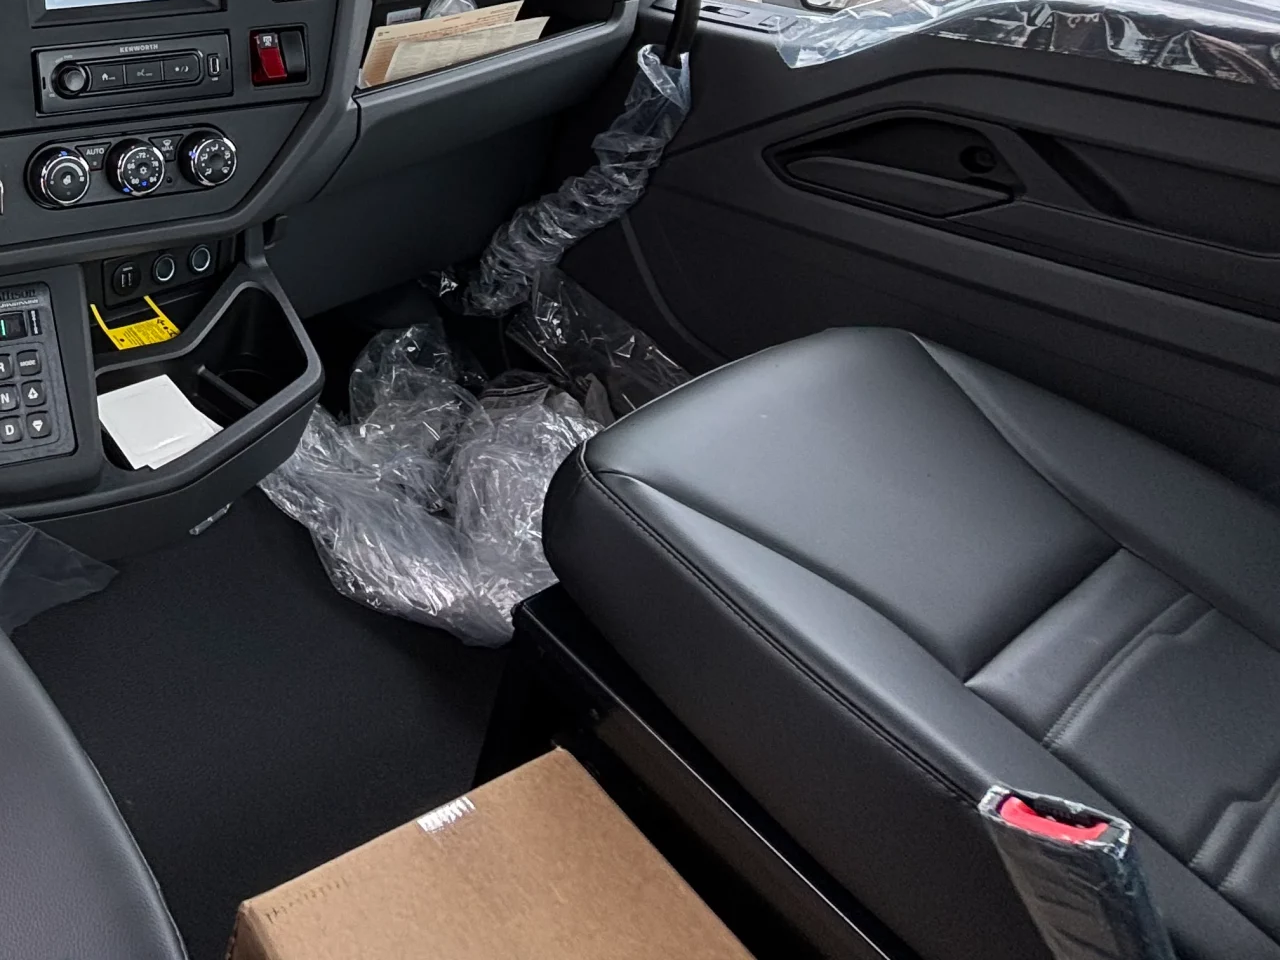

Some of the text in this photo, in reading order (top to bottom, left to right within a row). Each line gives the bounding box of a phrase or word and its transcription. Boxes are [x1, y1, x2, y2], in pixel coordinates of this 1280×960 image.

[119, 44, 159, 53] KENWORTH
[86, 147, 105, 156] AUTO
[20, 359, 36, 368] MODE
[0, 392, 10, 404] N
[5, 424, 15, 435] D
